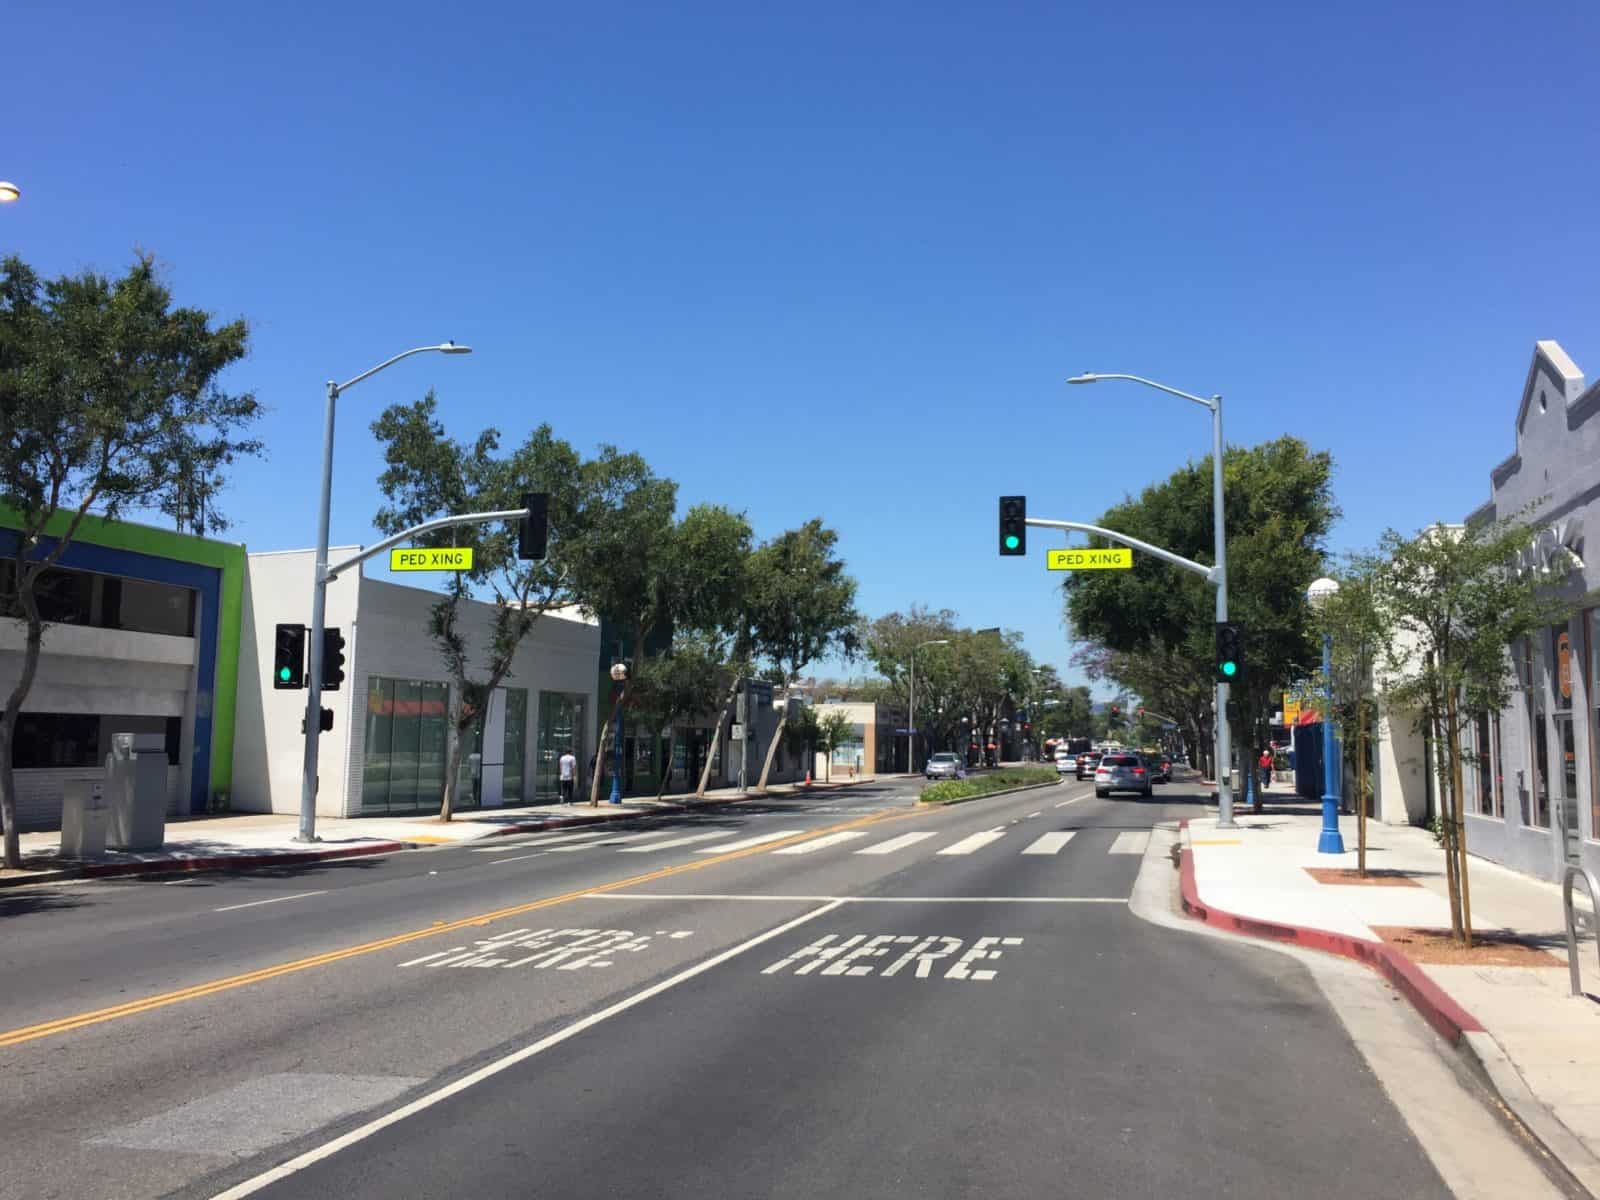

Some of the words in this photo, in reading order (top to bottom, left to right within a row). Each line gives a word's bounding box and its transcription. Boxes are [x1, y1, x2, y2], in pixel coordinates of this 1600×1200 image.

[400, 554, 426, 565] PED
[432, 553, 463, 565] XING
[1057, 554, 1084, 565] PED
[1089, 553, 1122, 564] XING
[760, 934, 1024, 979] HERE
